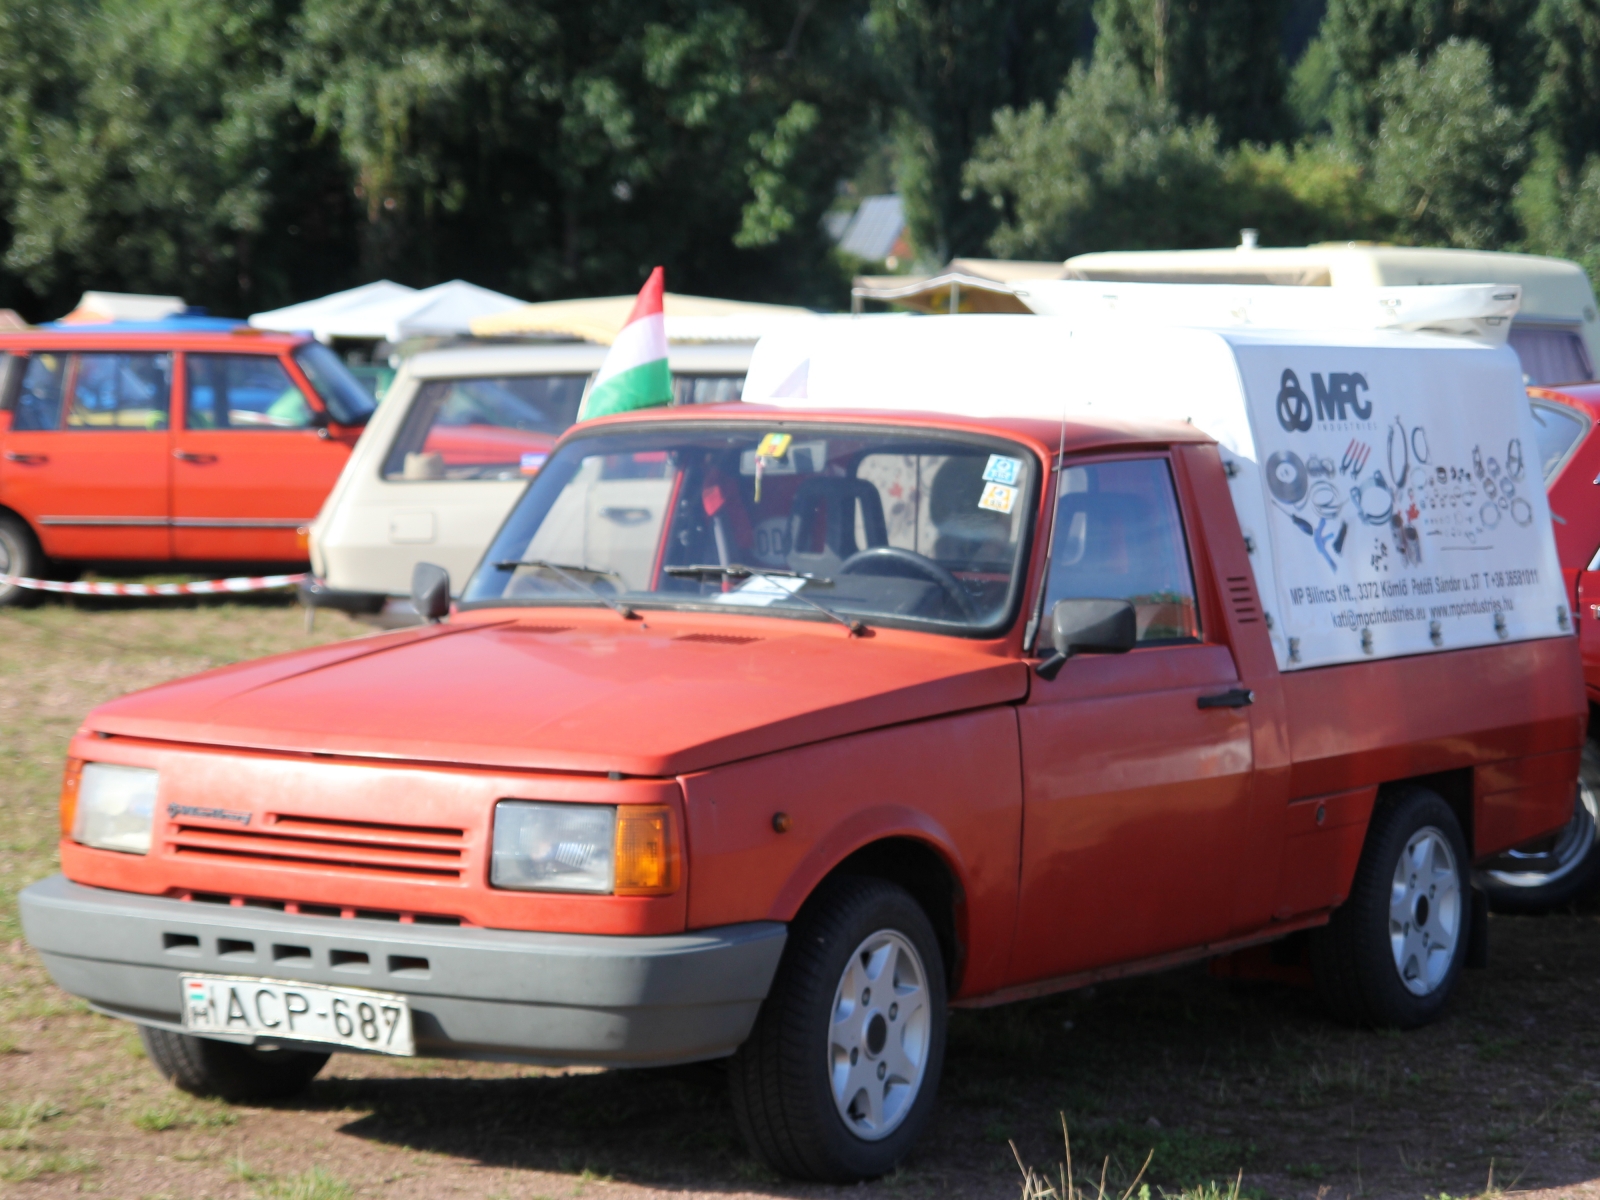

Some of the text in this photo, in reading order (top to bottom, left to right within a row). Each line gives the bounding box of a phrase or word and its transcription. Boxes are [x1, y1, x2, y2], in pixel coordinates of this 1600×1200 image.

[1310, 372, 1373, 421] MPC
[1317, 421, 1378, 432] INDUSTRIES
[1290, 588, 1304, 605] MP
[1305, 586, 1337, 604] Bilincs
[1357, 582, 1380, 600] 3372
[1470, 573, 1479, 590] 37
[1330, 596, 1514, 632] kati@mpcindustries.eu www.mpcindustries.hu
[226, 986, 401, 1045] ACP-687
